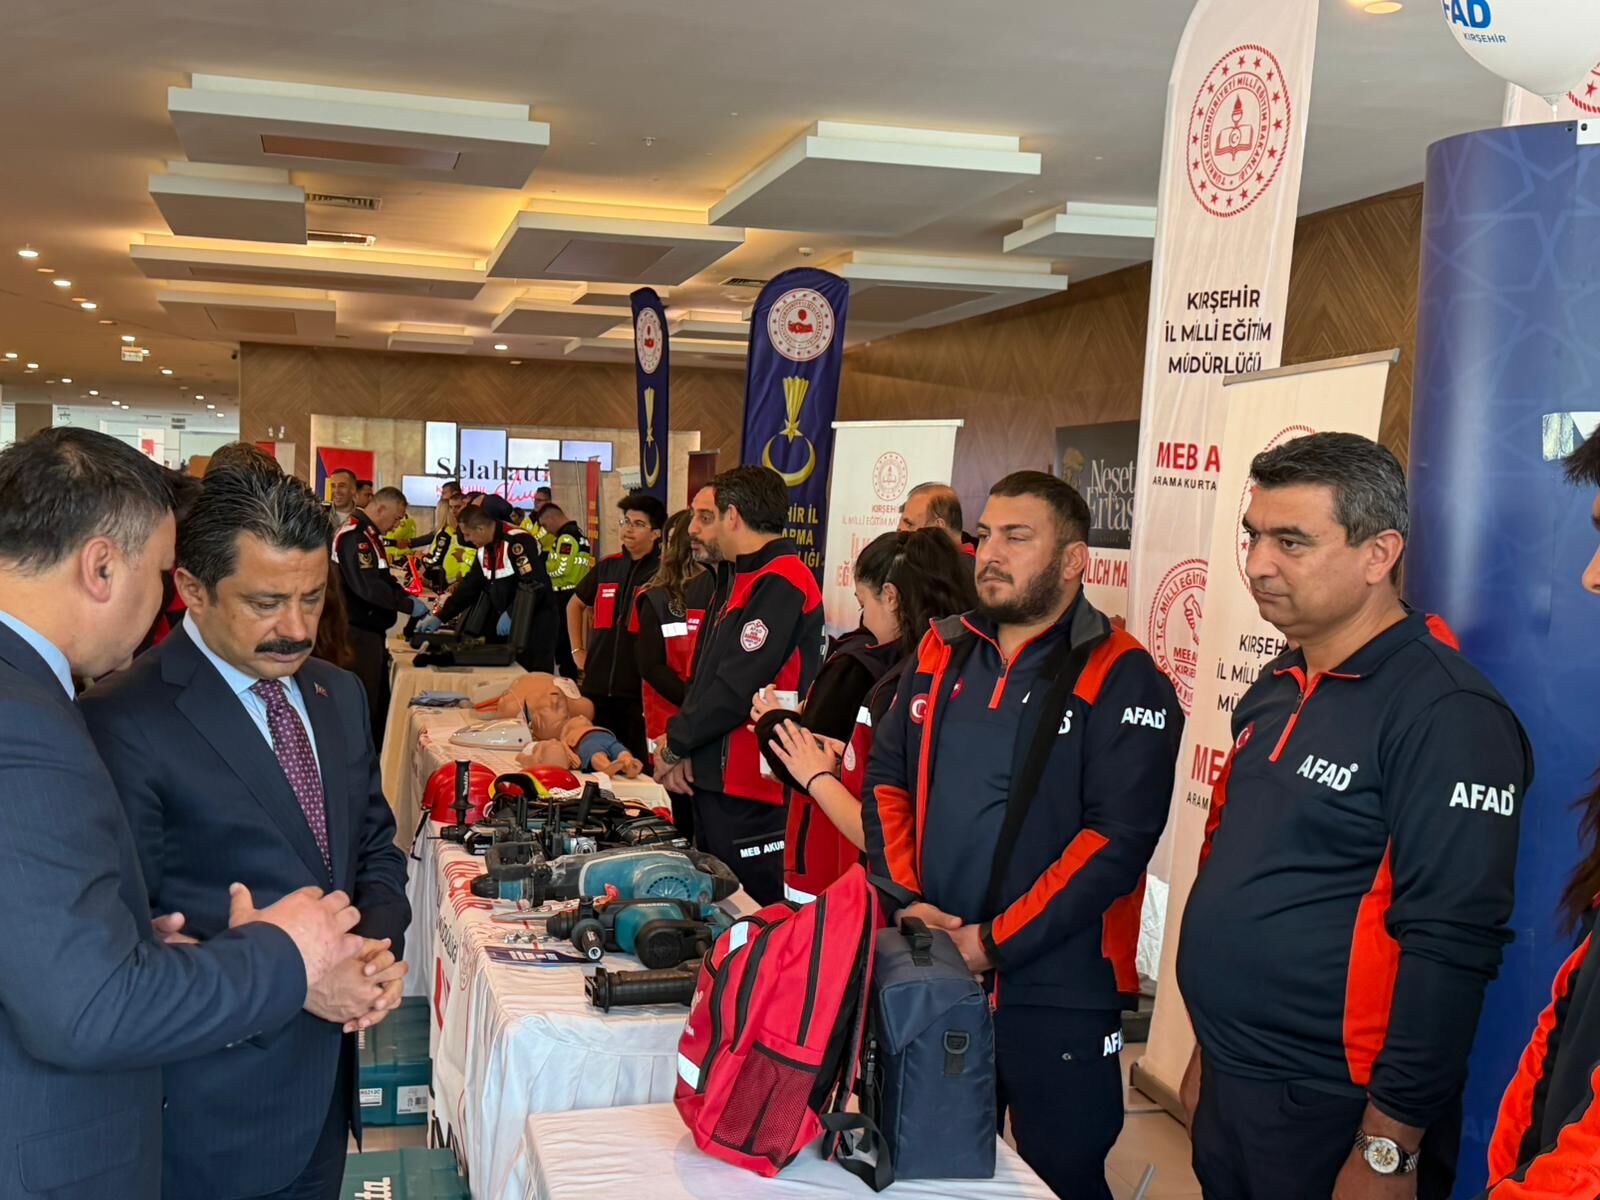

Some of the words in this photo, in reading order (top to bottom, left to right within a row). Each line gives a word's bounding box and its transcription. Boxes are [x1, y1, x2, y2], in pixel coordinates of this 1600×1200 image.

[1187, 284, 1260, 314] KIRŞEHİR
[1165, 320, 1177, 342] İL
[1181, 319, 1219, 342] MİLLİ
[1222, 317, 1272, 341] EĞİTİM
[1168, 352, 1262, 374] MÜDÜRLÜĞÜ
[1156, 441, 1198, 471] MEB
[1216, 657, 1227, 680] İL
[1120, 706, 1167, 730] AFAD
[1296, 754, 1359, 791] AFAD
[1449, 782, 1515, 816] AFAD
[740, 846, 761, 858] MEB
